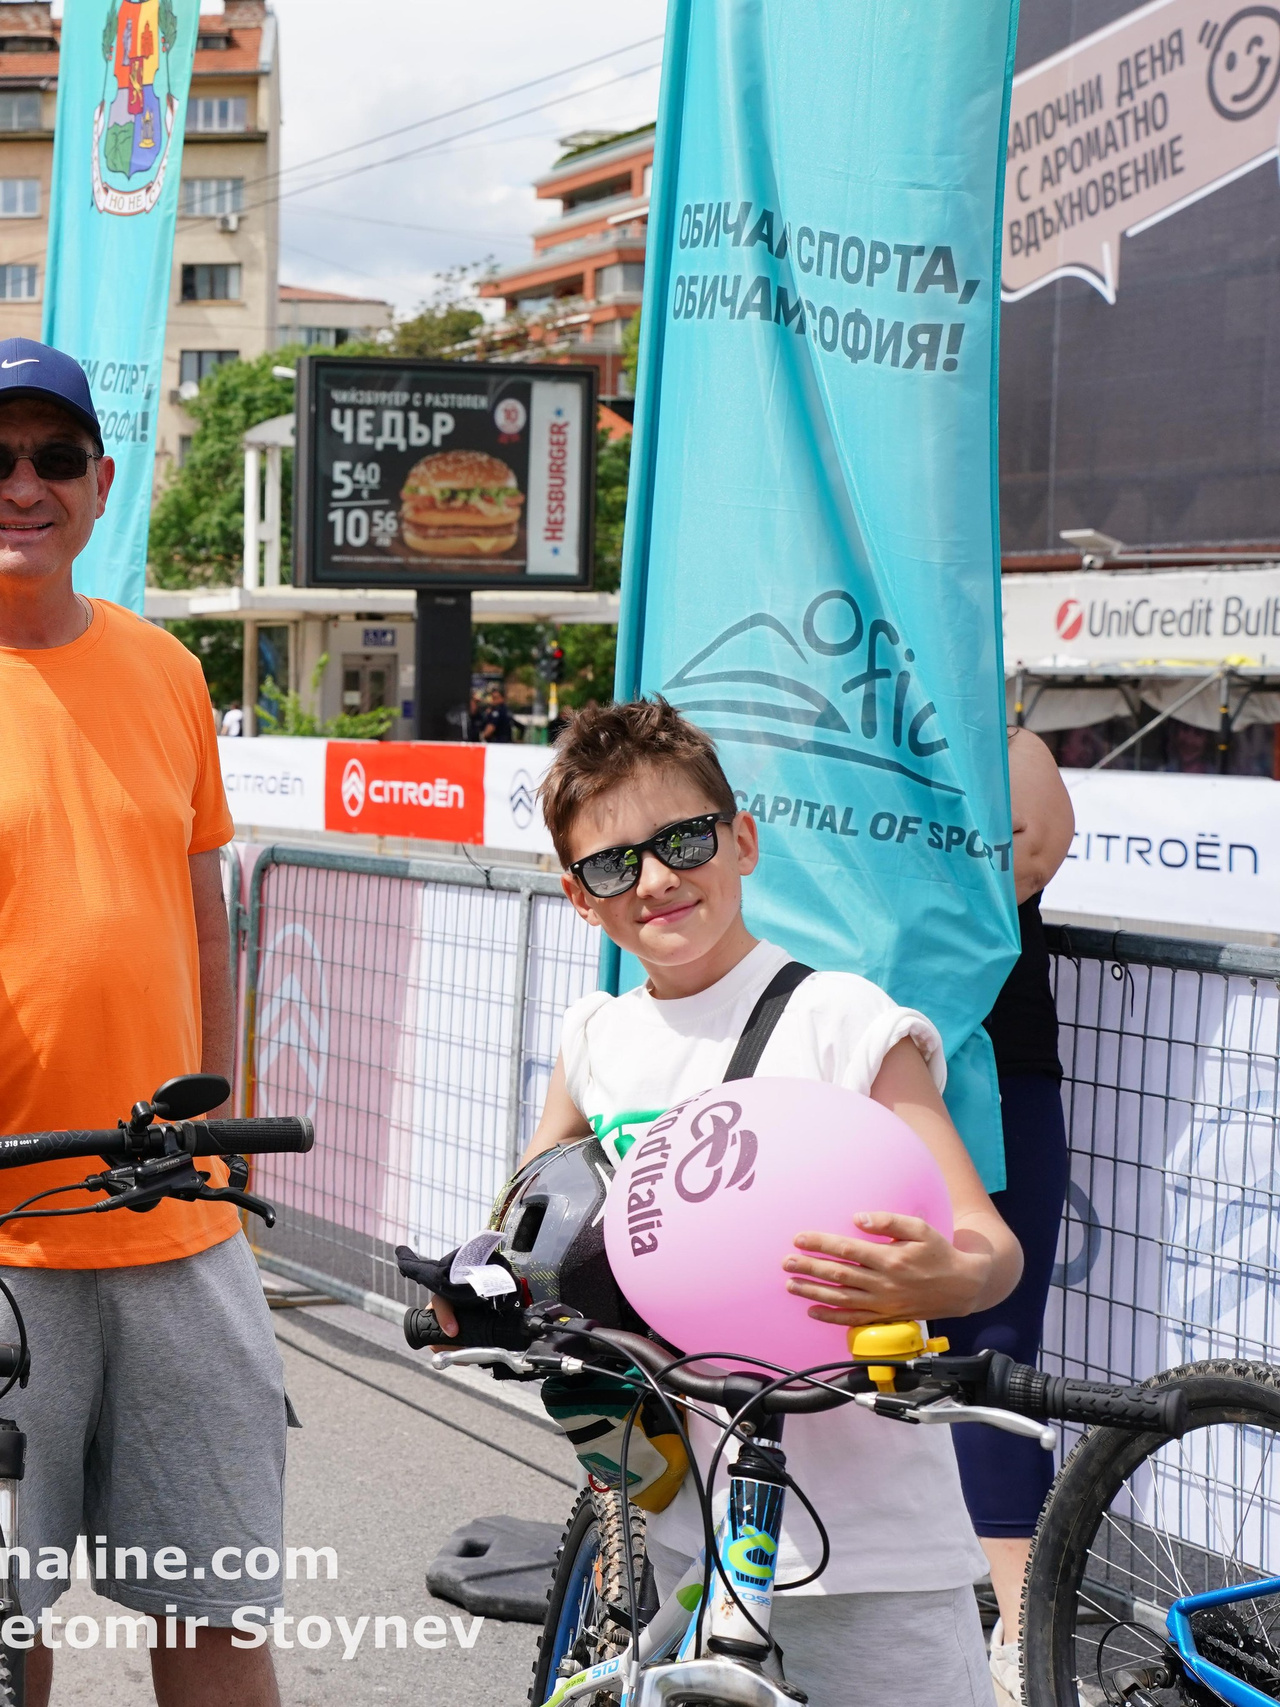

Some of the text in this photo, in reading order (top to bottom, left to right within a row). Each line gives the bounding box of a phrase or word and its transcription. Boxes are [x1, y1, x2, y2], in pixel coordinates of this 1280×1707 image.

[1116, 27, 1186, 108] ДЕНЯ
[1016, 90, 1168, 203] С АРОМАТНО
[1008, 133, 1186, 258] ВДЪХНОВЕНИЕ
[796, 225, 981, 305] СПОРТА,
[330, 407, 456, 452] ЧЕДЪР
[544, 420, 570, 542] HESBURGER
[1088, 598, 1213, 638] UniCredit
[368, 777, 465, 810] CITROËN
[732, 789, 859, 838] CAPITAL
[868, 811, 923, 844] OF
[4, 1139, 18, 1148] 318
